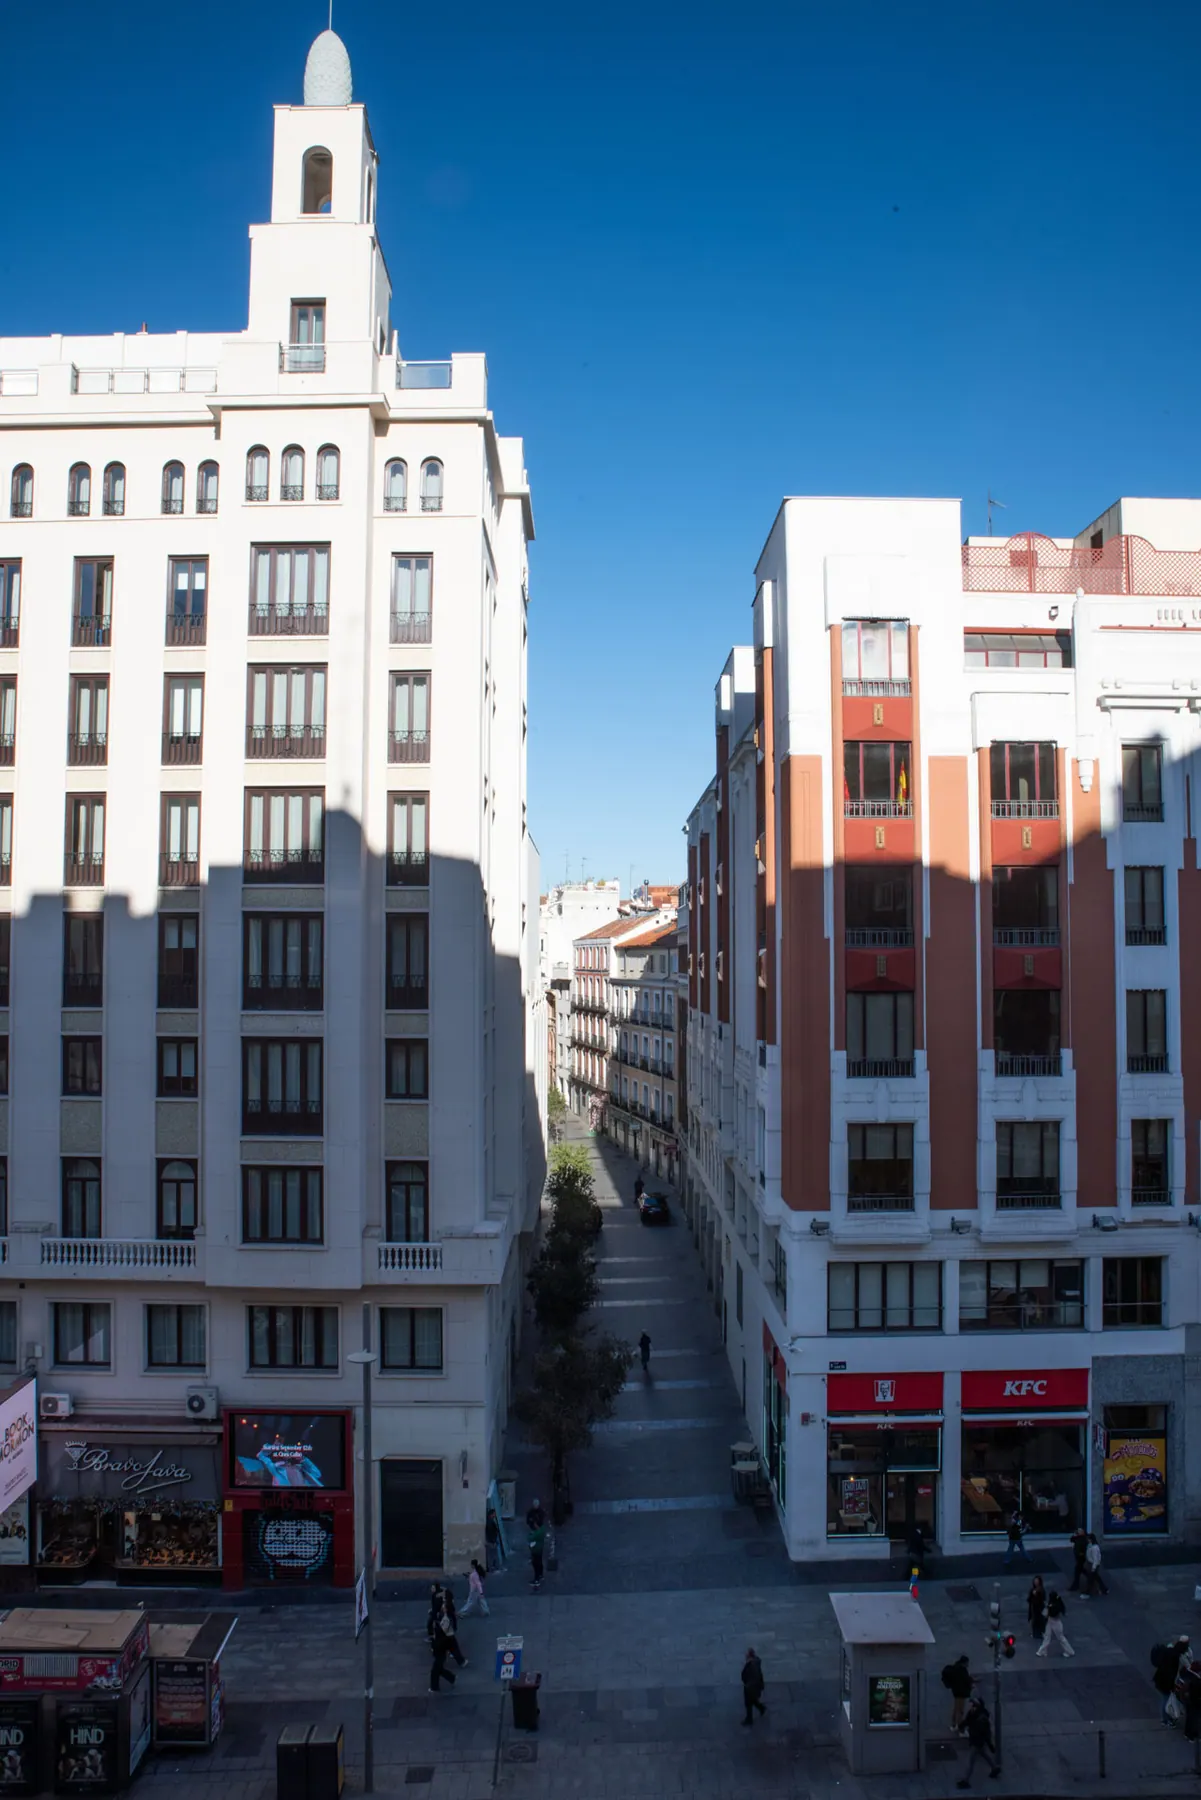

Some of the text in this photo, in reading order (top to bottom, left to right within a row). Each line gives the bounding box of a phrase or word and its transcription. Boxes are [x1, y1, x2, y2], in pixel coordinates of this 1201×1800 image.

[1003, 1379, 1048, 1397] KFC
[5, 1412, 28, 1441] BOOK
[79, 1448, 142, 1472] Bravo
[70, 1727, 105, 1746] HIND
